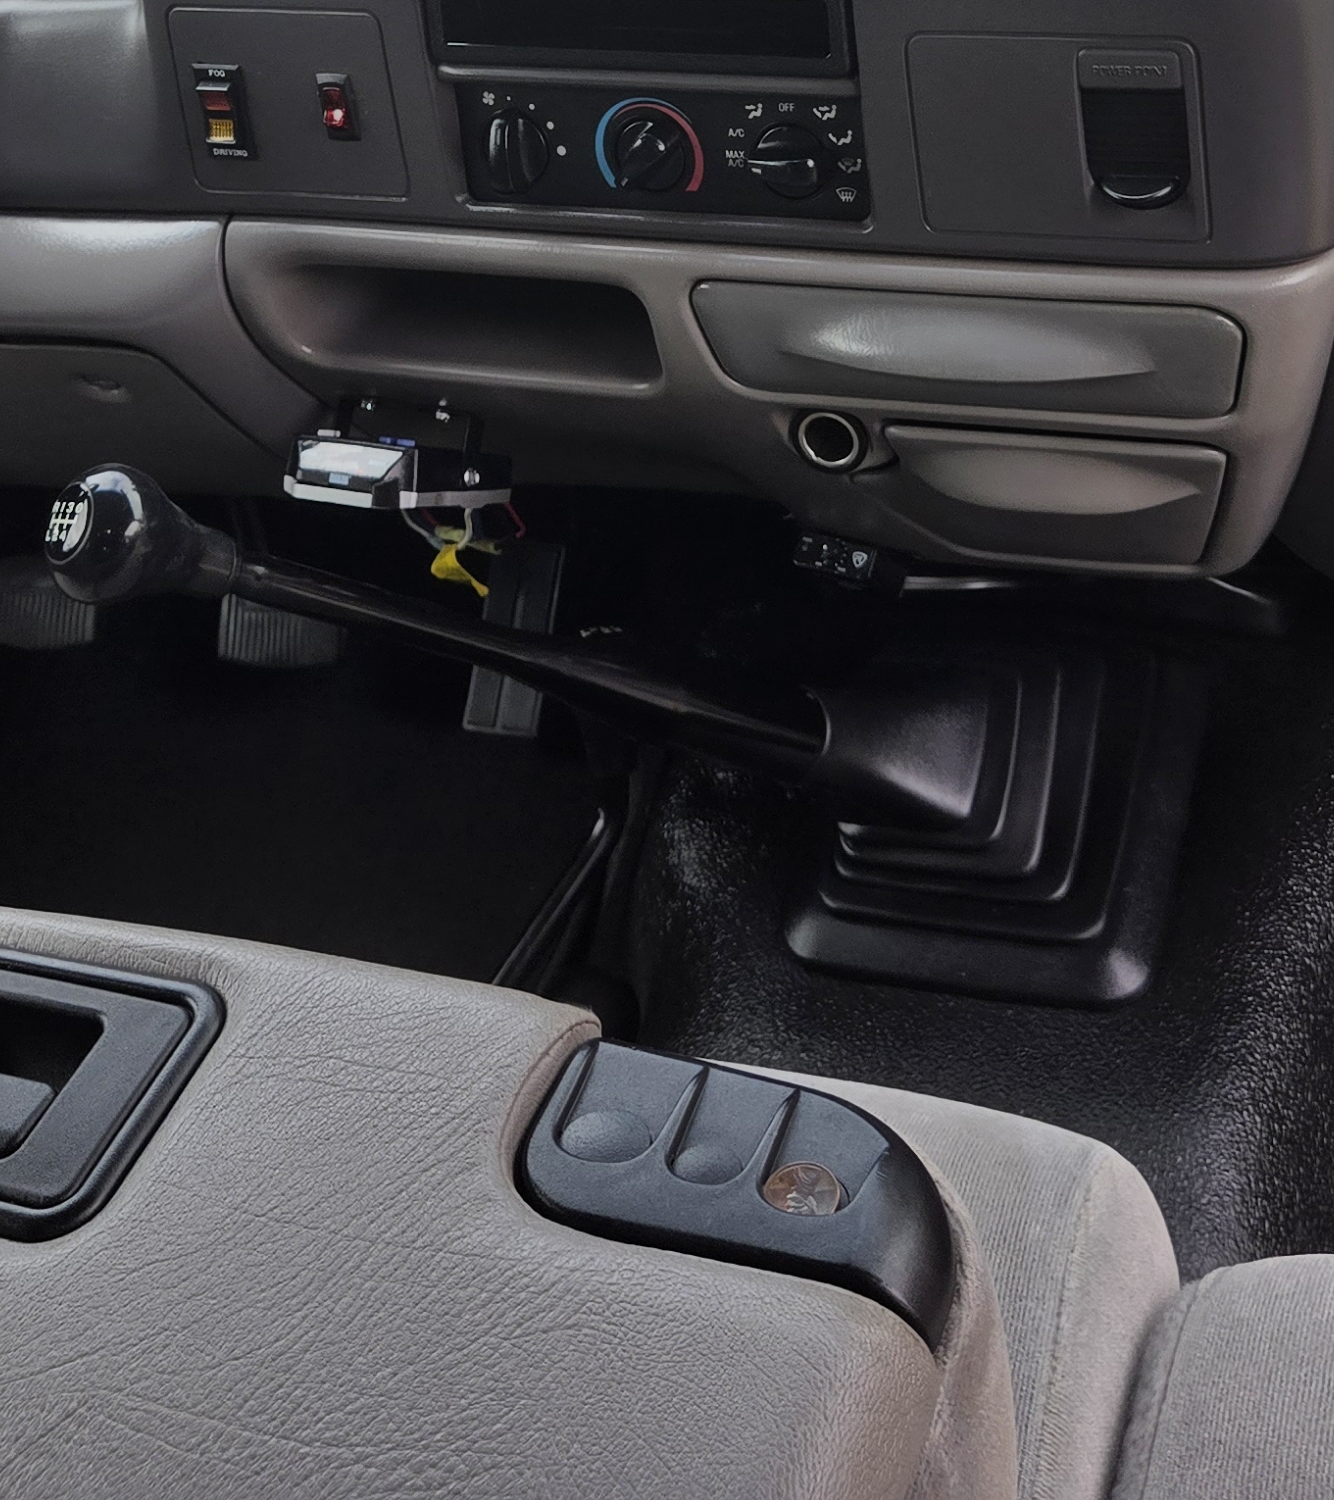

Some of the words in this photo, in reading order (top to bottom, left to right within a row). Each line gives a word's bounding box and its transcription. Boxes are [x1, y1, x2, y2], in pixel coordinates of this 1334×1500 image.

[208, 69, 225, 78] FOG
[778, 102, 795, 112] OFF
[728, 128, 745, 137] A/C
[213, 147, 248, 157] DRIVING
[725, 150, 745, 158] MAX
[728, 159, 744, 167] A/C
